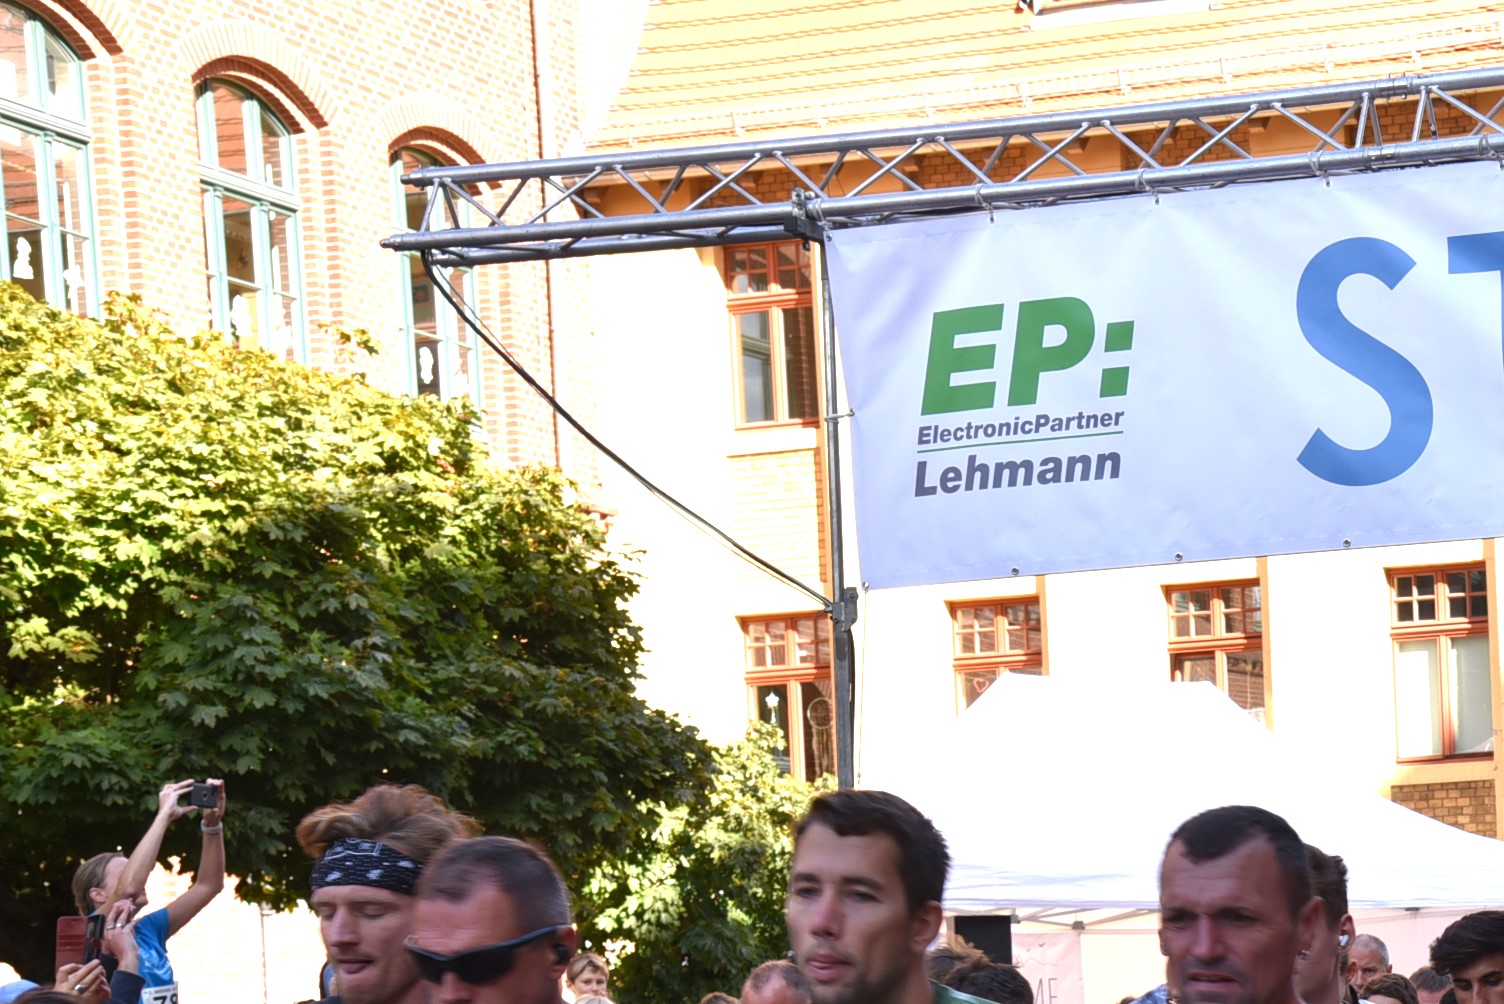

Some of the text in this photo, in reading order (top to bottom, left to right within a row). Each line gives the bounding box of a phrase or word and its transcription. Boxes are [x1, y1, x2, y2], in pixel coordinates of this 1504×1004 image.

[920, 296, 1135, 416] EP:
[917, 411, 1125, 445] ElectronicPartner
[914, 451, 1121, 497] Lehmann
